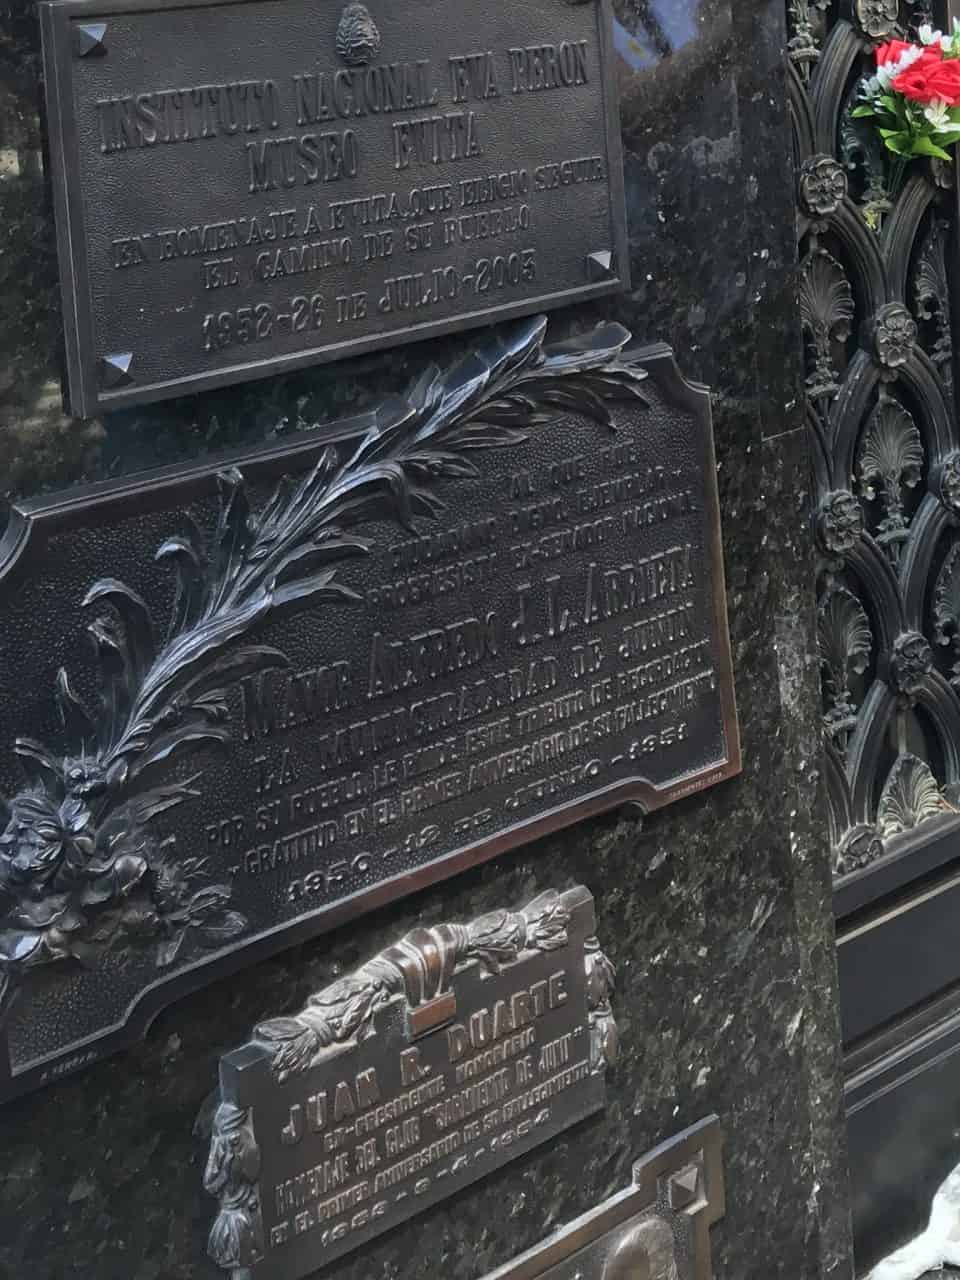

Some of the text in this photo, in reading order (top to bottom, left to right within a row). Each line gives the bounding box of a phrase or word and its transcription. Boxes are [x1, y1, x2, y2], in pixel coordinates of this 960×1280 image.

[96, 39, 589, 153] INSTITUTO NACIONAL EVA PERON
[247, 111, 482, 194] MUSEO EVITA
[112, 236, 143, 268] EN
[158, 208, 298, 261] HOMENAJE
[302, 206, 322, 236] A
[203, 204, 530, 289] EL CAMINO DE SU PUEBLO
[335, 291, 368, 323] DE
[368, 611, 500, 699] ALFREDO
[584, 542, 697, 624] ARRIETA
[289, 851, 372, 903] 1950
[504, 758, 602, 810] JUNIO
[629, 721, 688, 761] 1951
[344, 807, 369, 838] EN
[401, 771, 464, 816] PRIMER
[468, 731, 568, 791] ANIVERSARIO
[281, 969, 569, 1145] JUAN R. DUARTE
[318, 1180, 370, 1222] PRIMER
[374, 1130, 460, 1193] ANIVERSARIO
